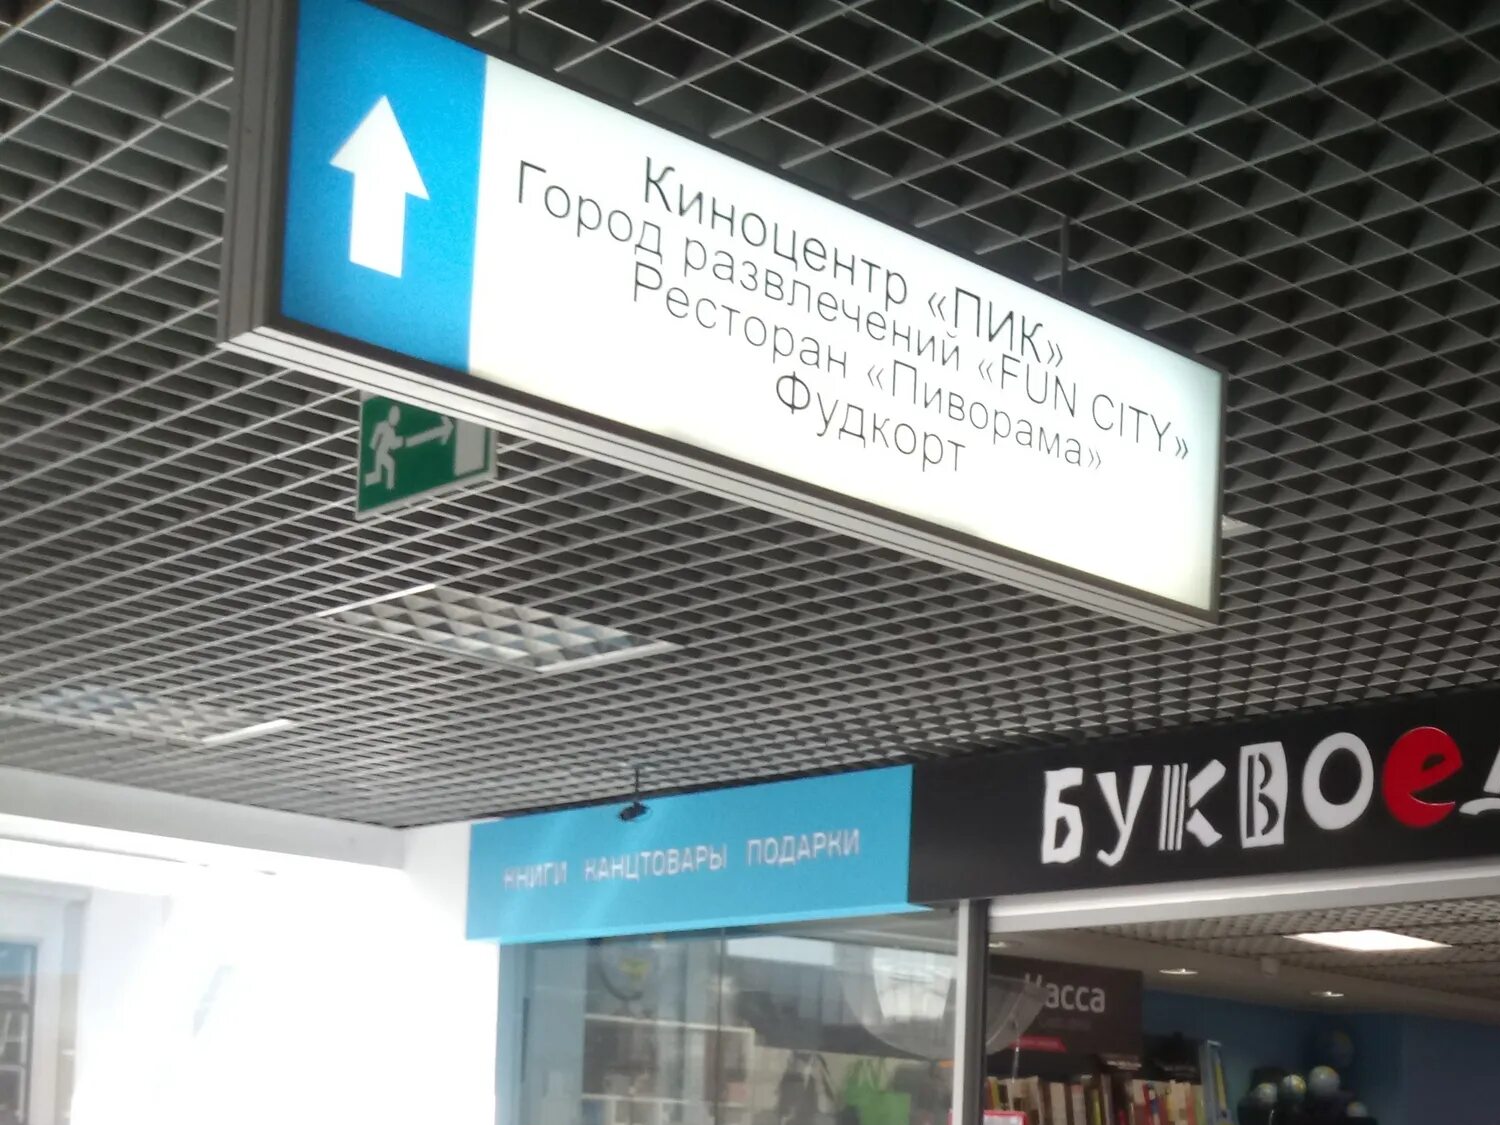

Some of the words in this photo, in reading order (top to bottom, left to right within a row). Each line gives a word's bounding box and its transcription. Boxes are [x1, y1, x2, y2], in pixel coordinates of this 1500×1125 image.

[518, 160, 663, 265] Город
[684, 237, 960, 371] развлечений
[978, 353, 1076, 418] «FUN
[1092, 393, 1189, 460] CITY»
[634, 261, 848, 378] Ресторан
[867, 359, 1102, 470] «Пиворама»
[645, 156, 907, 312] Киноцентр
[927, 286, 1064, 368] «ПИК»
[775, 370, 966, 472] Фудкорт
[503, 860, 568, 892] КНИГИ
[584, 843, 728, 882] КАНЦТОВАРЫ
[746, 829, 860, 867] ПОДАРКИ
